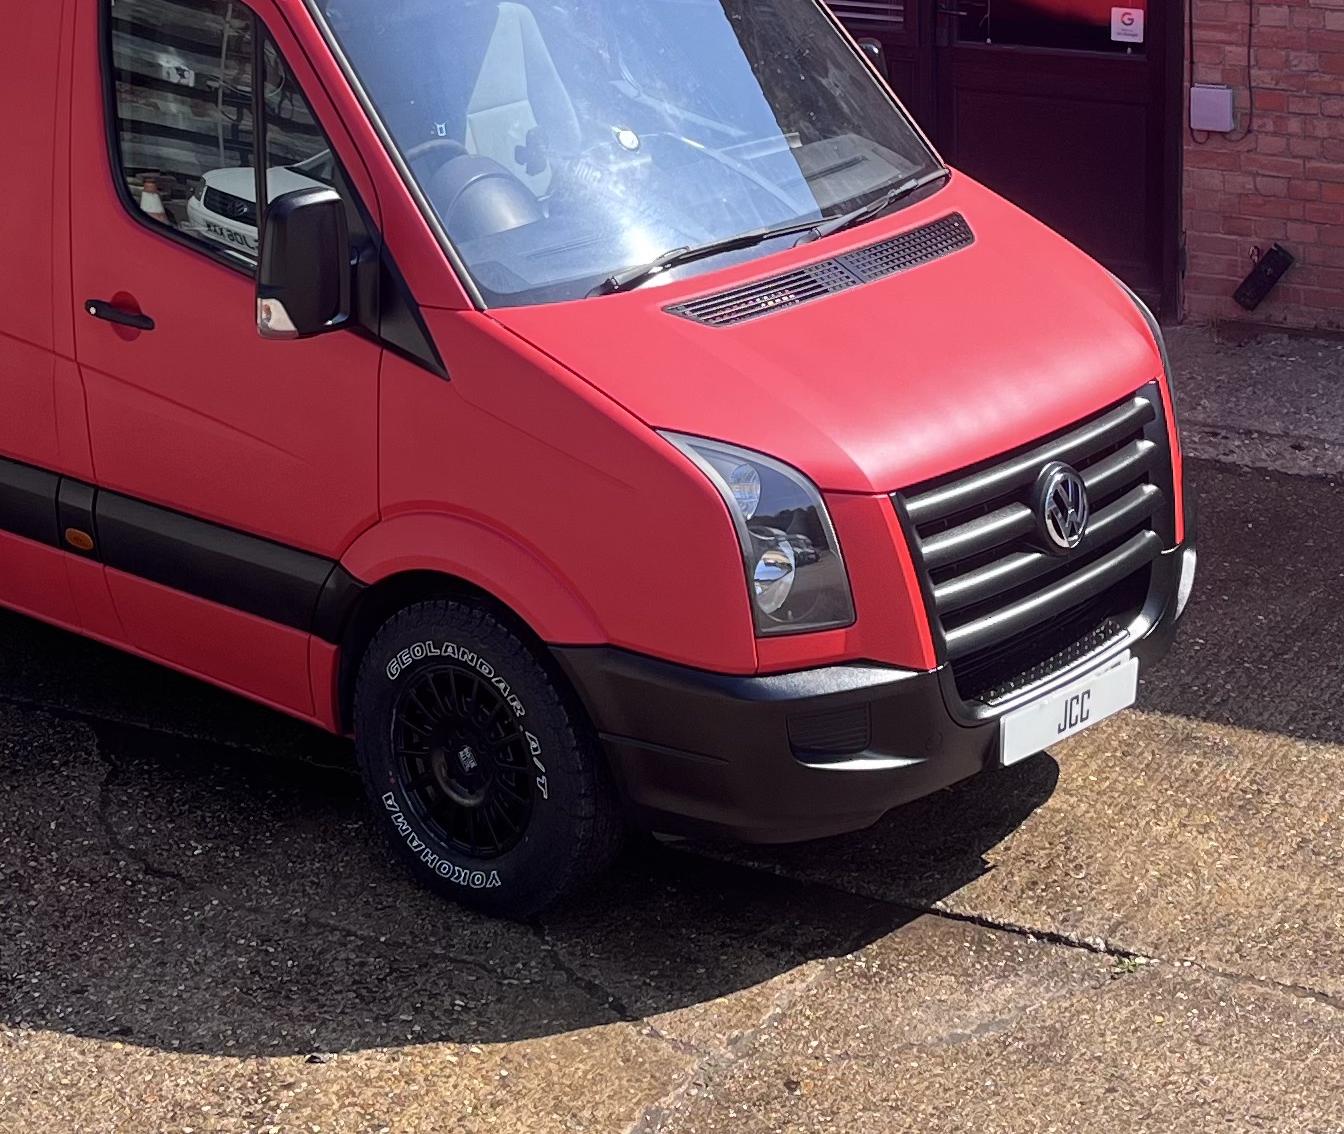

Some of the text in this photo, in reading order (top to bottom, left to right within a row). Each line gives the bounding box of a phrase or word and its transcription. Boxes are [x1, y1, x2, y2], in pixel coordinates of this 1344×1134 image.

[386, 641, 548, 799] GEOLANDAR A/T
[1057, 689, 1091, 735] JCC
[382, 792, 502, 888] YOKOHAMA
